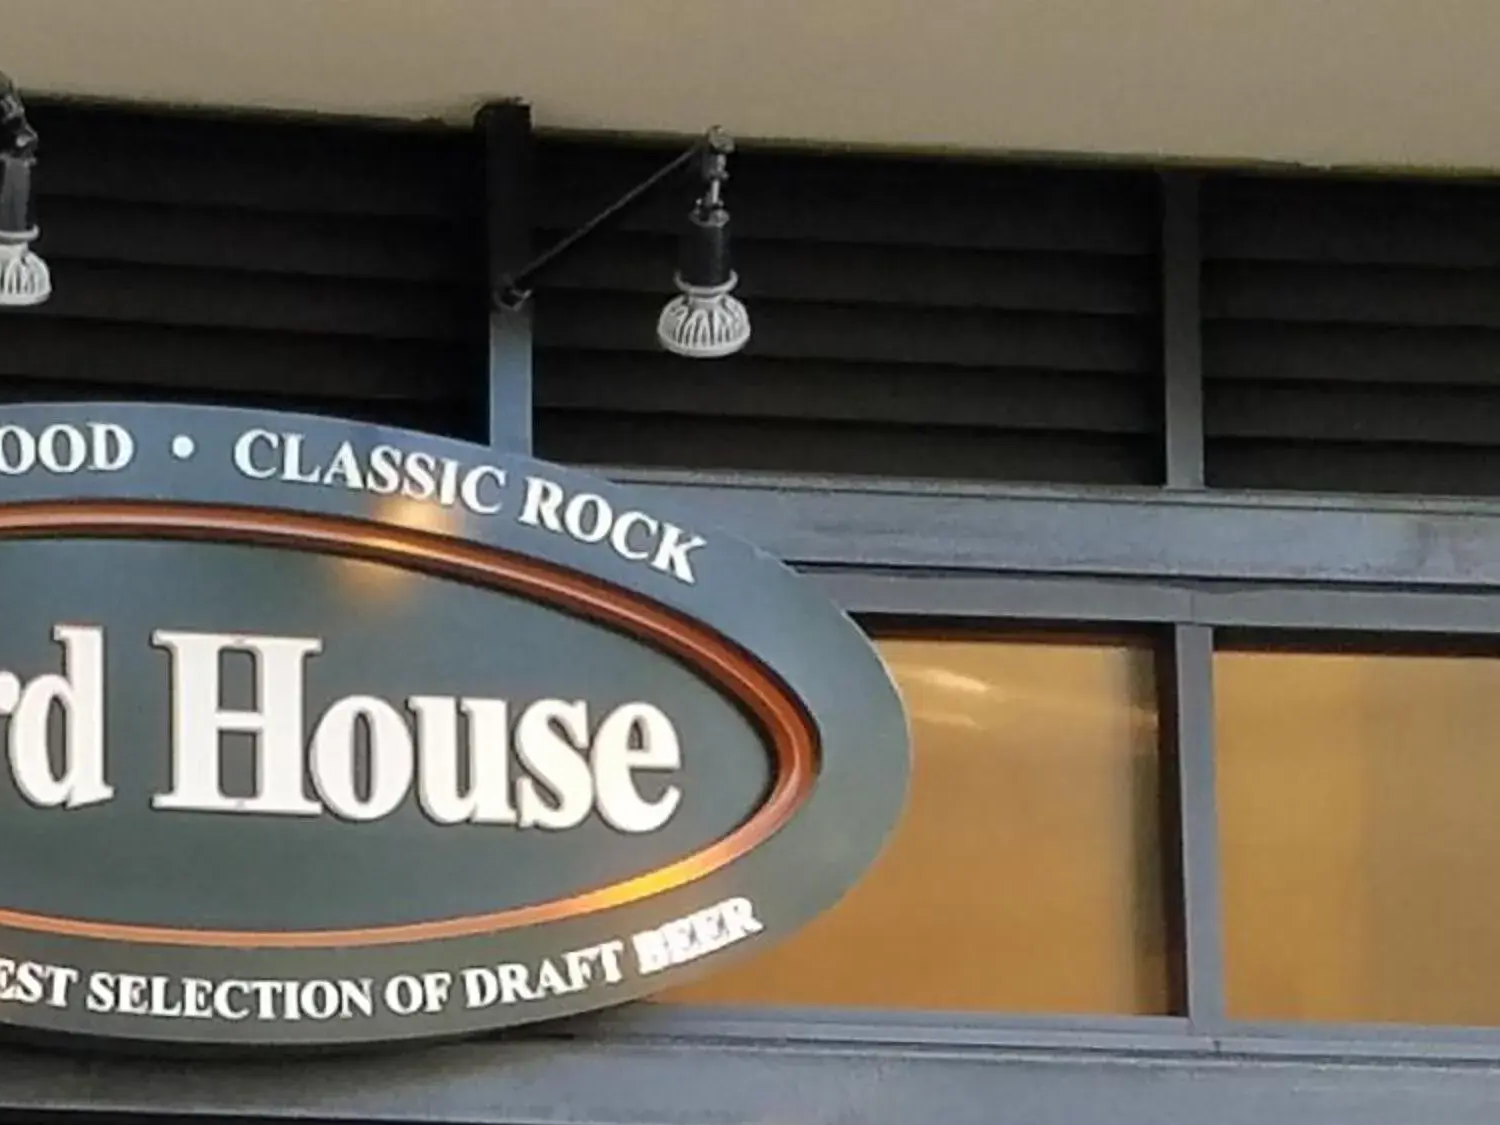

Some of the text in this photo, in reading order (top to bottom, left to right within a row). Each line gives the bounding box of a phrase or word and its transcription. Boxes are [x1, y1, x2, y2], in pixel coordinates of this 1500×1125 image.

[234, 429, 506, 514] CLASSIC
[519, 477, 708, 584] ROCK
[152, 629, 682, 834] House
[86, 972, 373, 1021] SELECTION
[386, 972, 451, 1014] OF
[461, 941, 624, 1010] DRAFT
[632, 896, 765, 974] BEER
